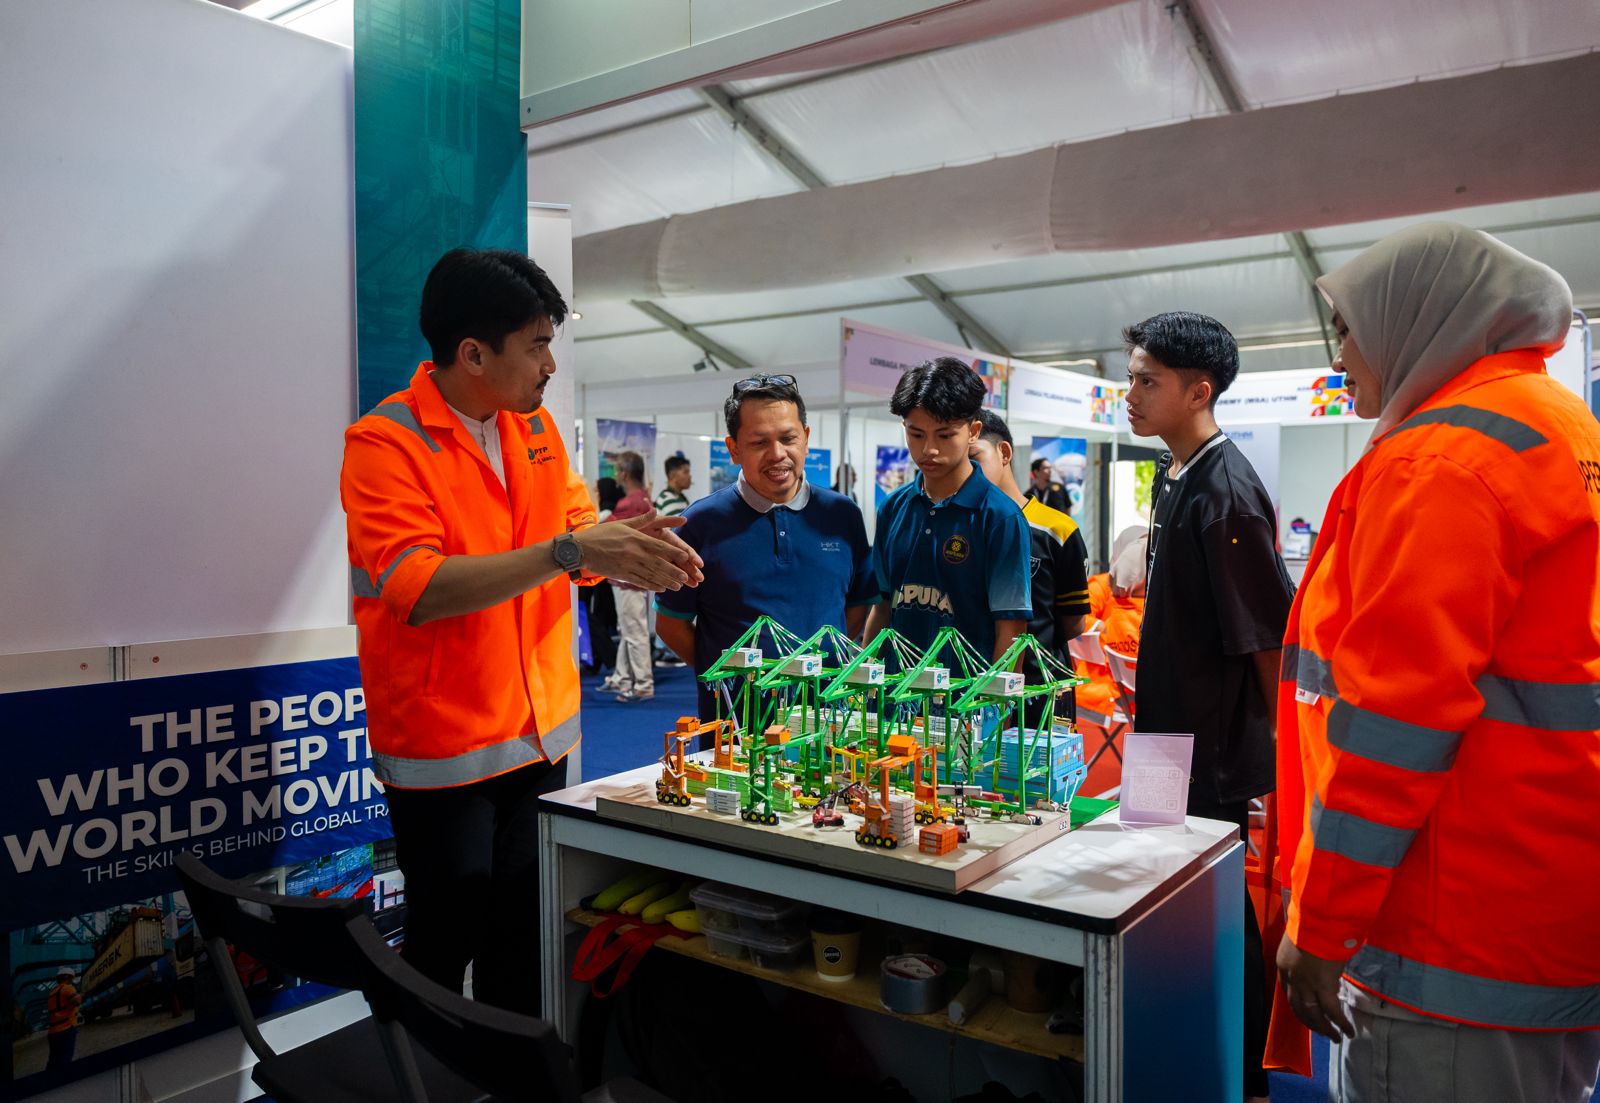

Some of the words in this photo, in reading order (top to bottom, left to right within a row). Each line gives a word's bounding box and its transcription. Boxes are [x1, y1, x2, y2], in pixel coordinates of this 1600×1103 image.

[130, 704, 235, 753] THE
[250, 687, 367, 736] PEOP
[37, 758, 190, 817] WHO
[206, 735, 329, 788] KEEP
[3, 797, 227, 874] WORLD
[82, 860, 129, 884] THE
[134, 843, 204, 873] SKILS
[210, 826, 287, 856] BEHIND
[290, 810, 362, 838] GLOBAL
